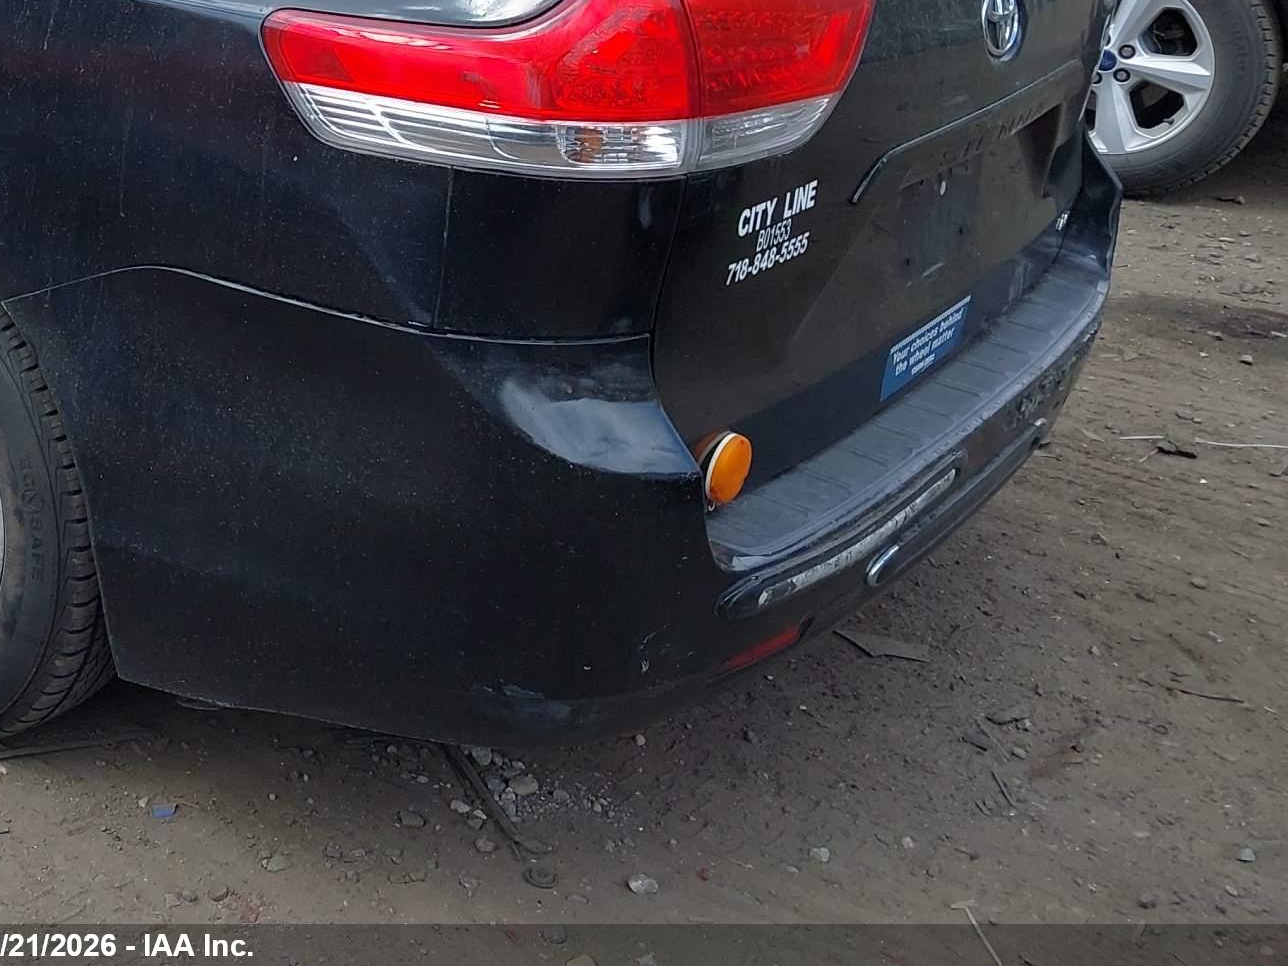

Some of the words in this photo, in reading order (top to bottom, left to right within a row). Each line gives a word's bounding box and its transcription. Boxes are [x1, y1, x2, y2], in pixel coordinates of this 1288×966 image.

[737, 196, 778, 237] CITY
[782, 179, 818, 218] LINE
[755, 218, 792, 253] B01553
[726, 231, 810, 286] 718-848-5555
